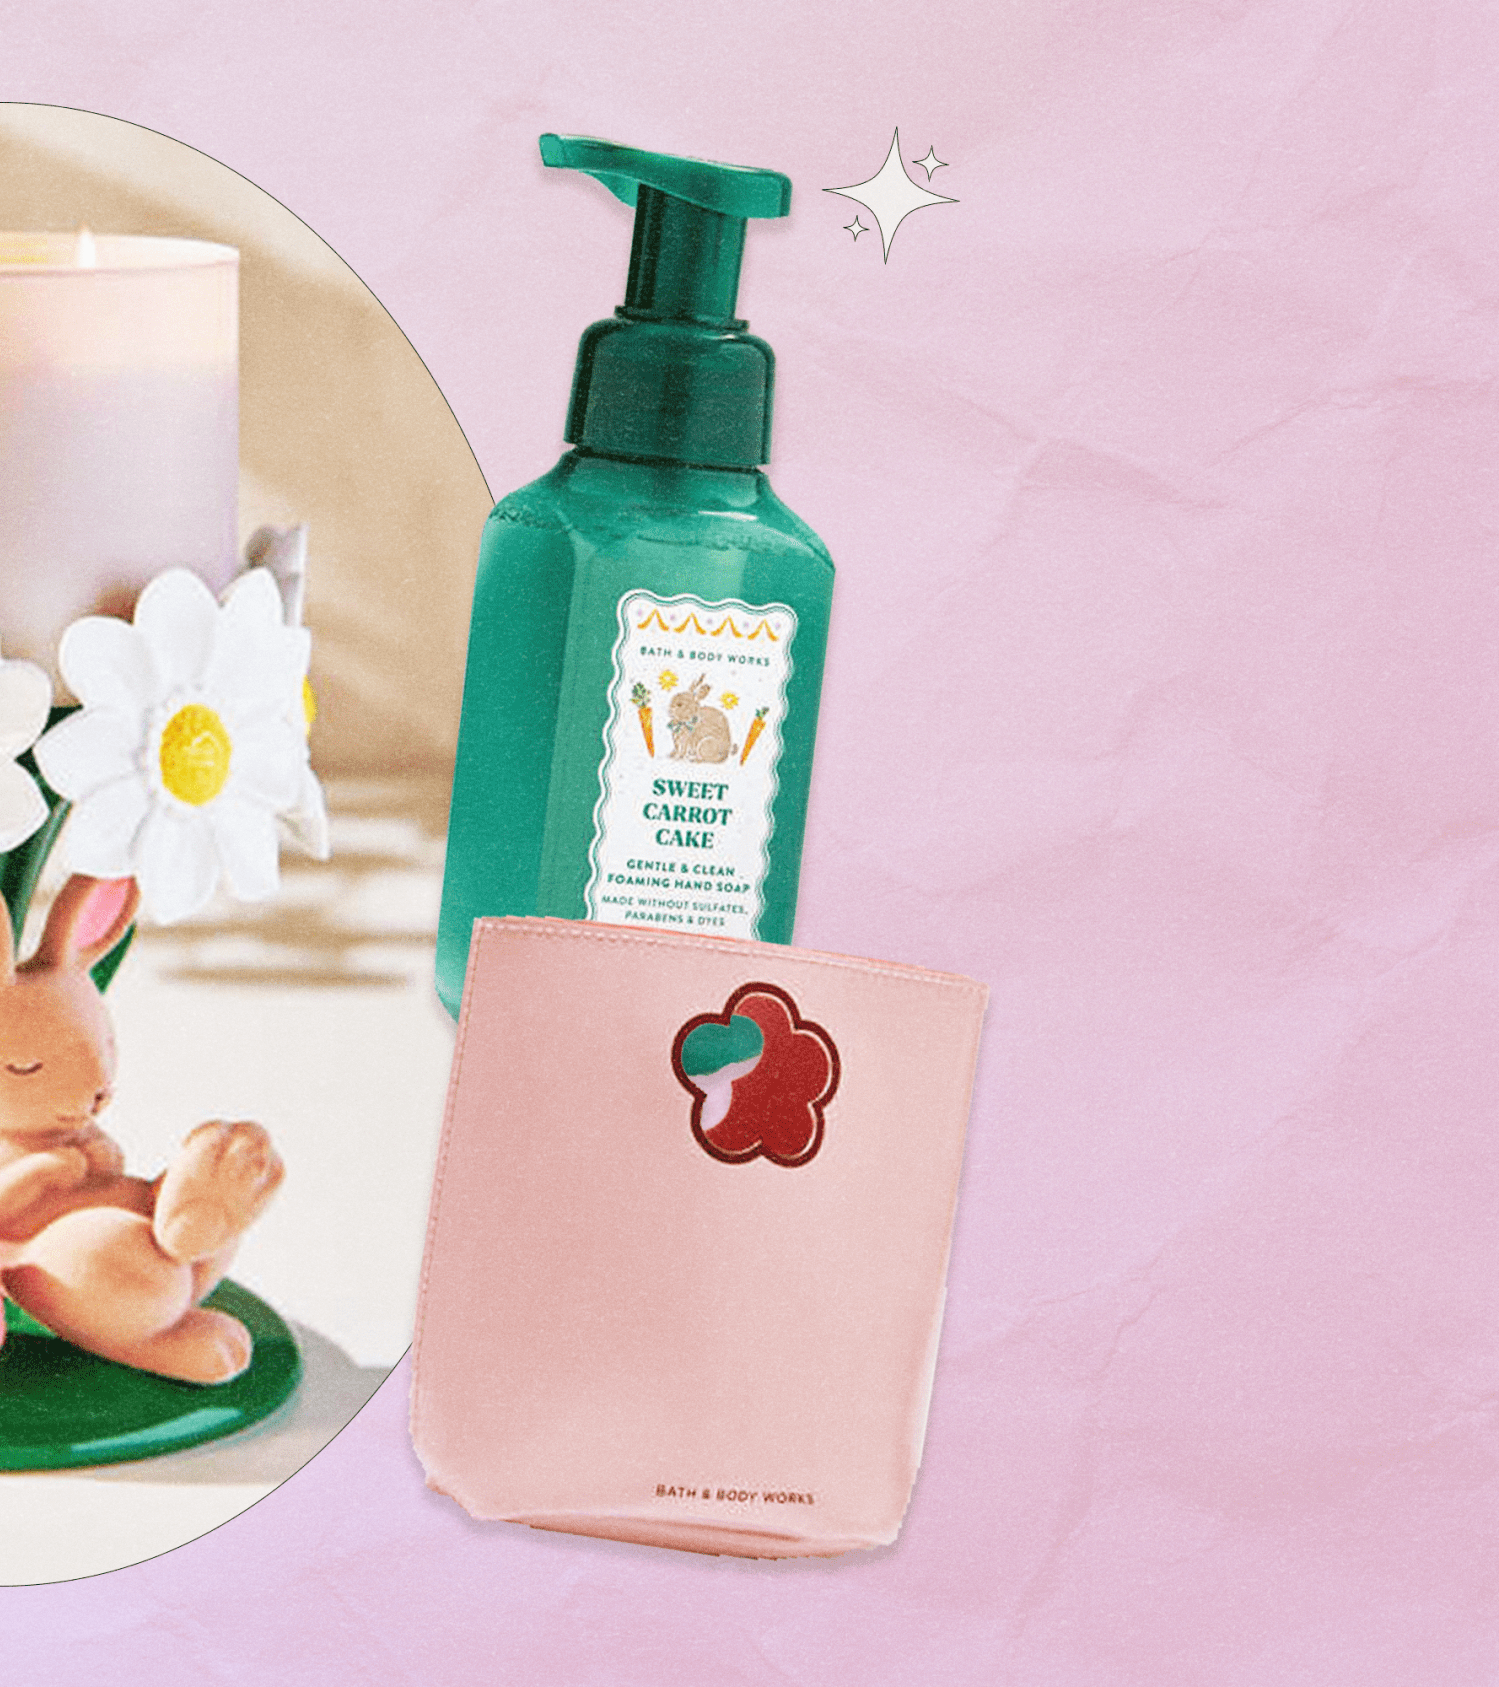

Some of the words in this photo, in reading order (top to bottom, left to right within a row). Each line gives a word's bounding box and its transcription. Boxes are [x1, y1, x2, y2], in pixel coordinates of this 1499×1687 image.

[640, 646, 673, 658] BATH
[677, 649, 684, 659] &
[689, 650, 723, 661] BODY
[727, 655, 771, 667] WORKS
[653, 778, 729, 801] SWEET
[643, 802, 733, 826] CARROT
[656, 829, 714, 849] CAKE
[627, 859, 678, 873] GENTLE
[681, 863, 689, 873] &
[692, 864, 735, 877] CLEAN
[608, 873, 670, 889] FOAMING
[675, 878, 712, 892] HAND
[716, 881, 750, 894] SOAP
[602, 895, 635, 906] MADE
[638, 897, 690, 910] WITHOUT
[625, 910, 685, 924] PARABENS
[688, 914, 695, 925] &
[698, 915, 725, 926] DYES
[656, 1484, 696, 1498] BATH
[702, 1489, 710, 1499] &
[716, 1489, 758, 1502] BODY
[763, 1492, 815, 1505] WORKS
